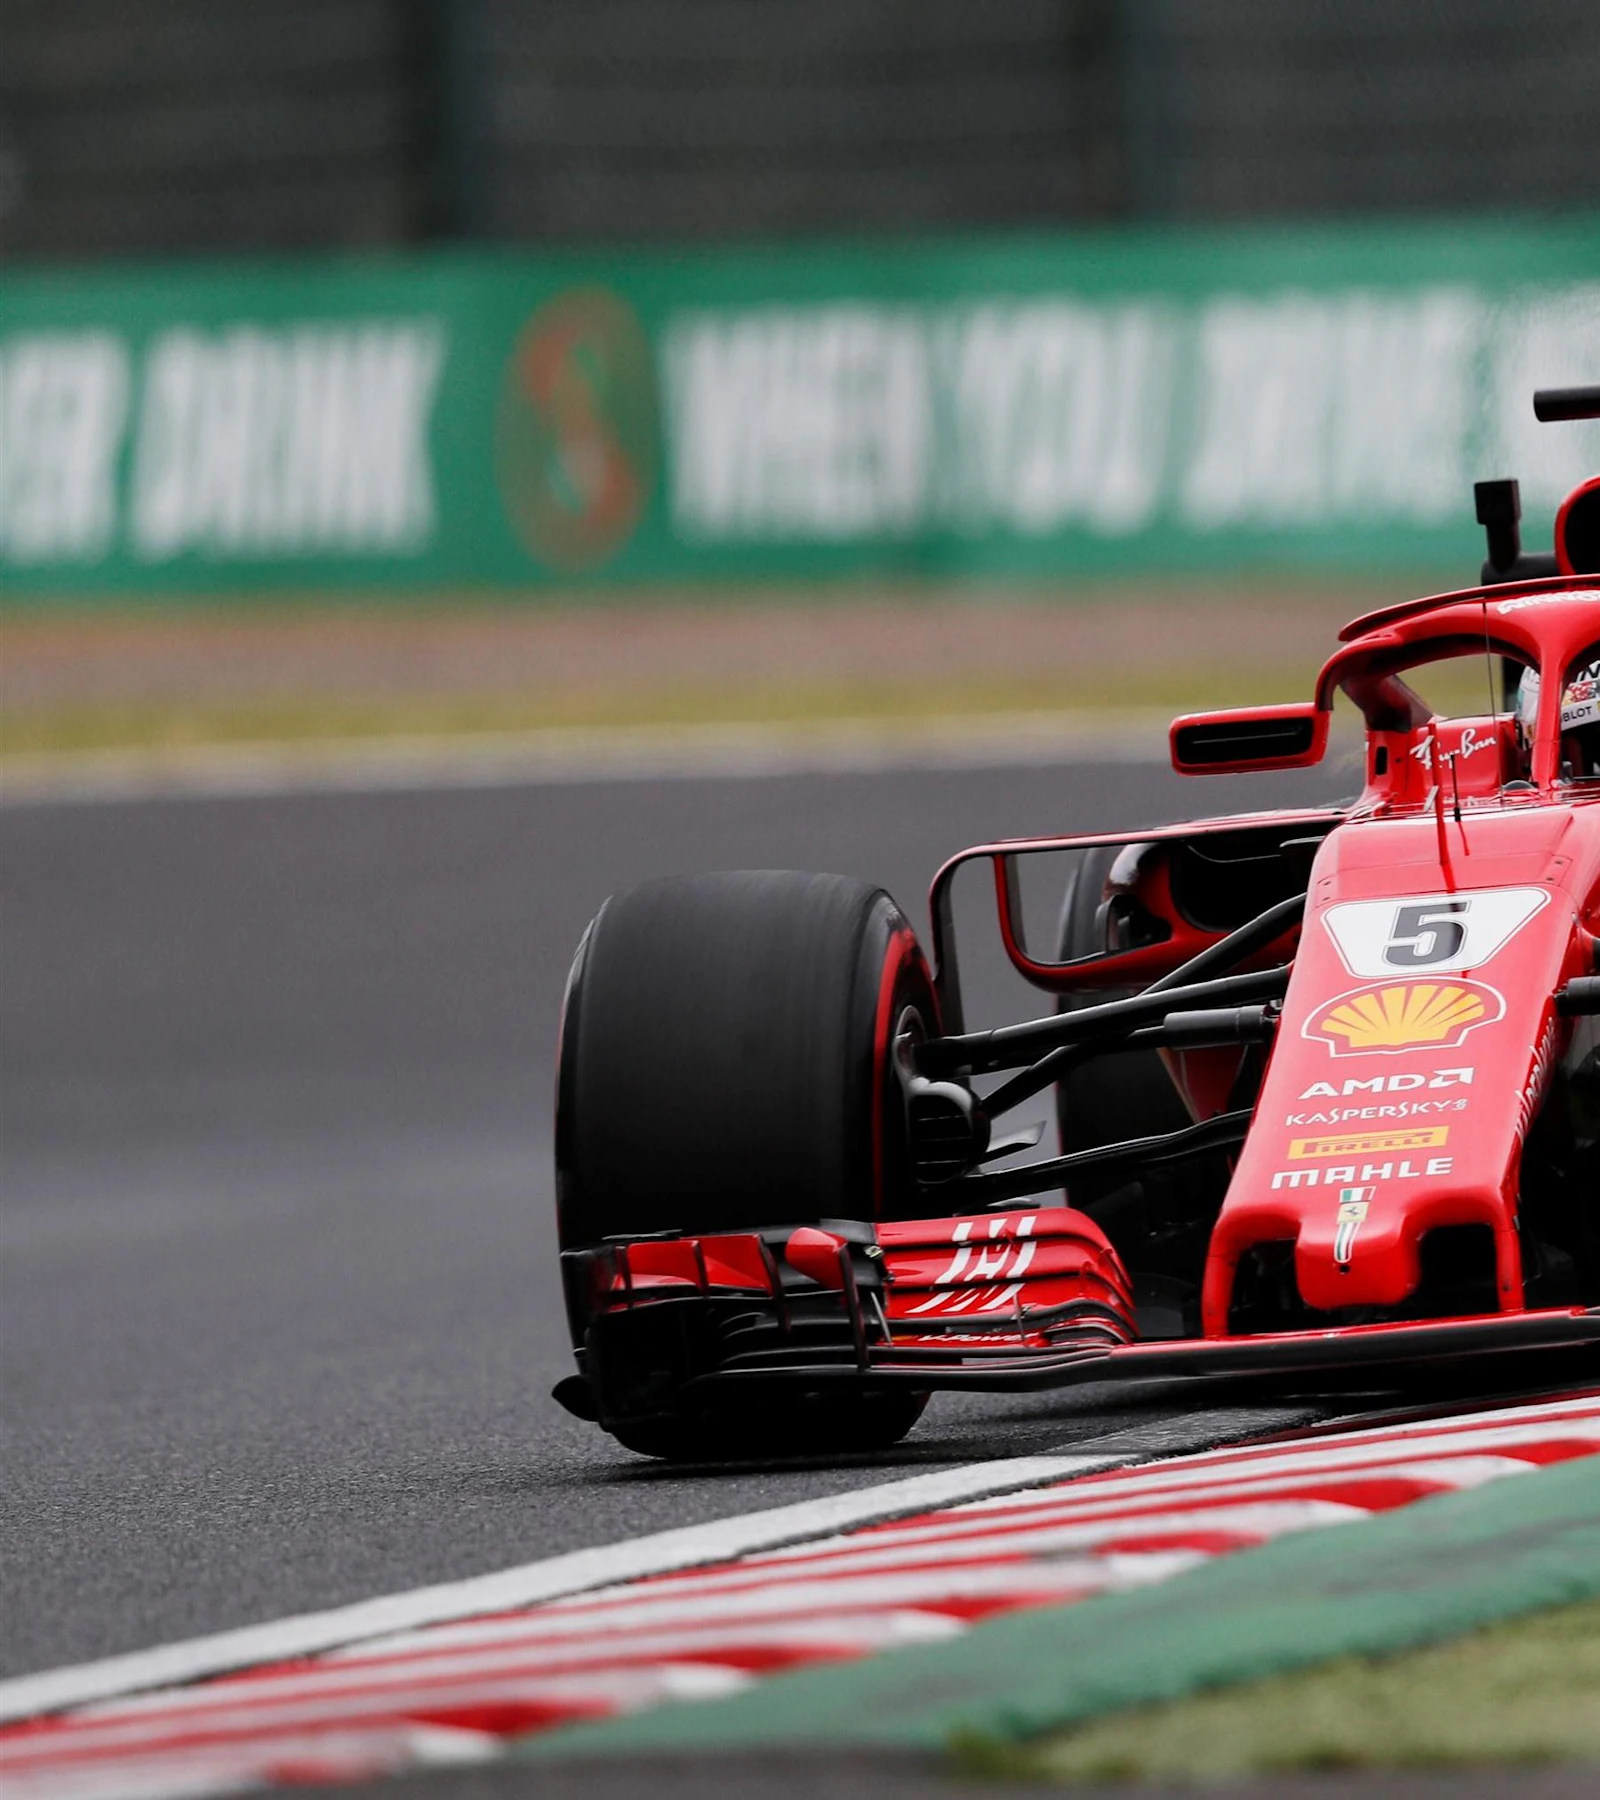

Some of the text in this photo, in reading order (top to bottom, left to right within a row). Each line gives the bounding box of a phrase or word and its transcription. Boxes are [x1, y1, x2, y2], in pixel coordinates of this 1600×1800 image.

[1382, 901, 1471, 967] 5
[1298, 1073, 1426, 1100] AMD
[1285, 1099, 1452, 1127] KASPERSKY
[1302, 1131, 1434, 1155] PIRELLI
[1271, 1156, 1454, 1190] MAHLE
